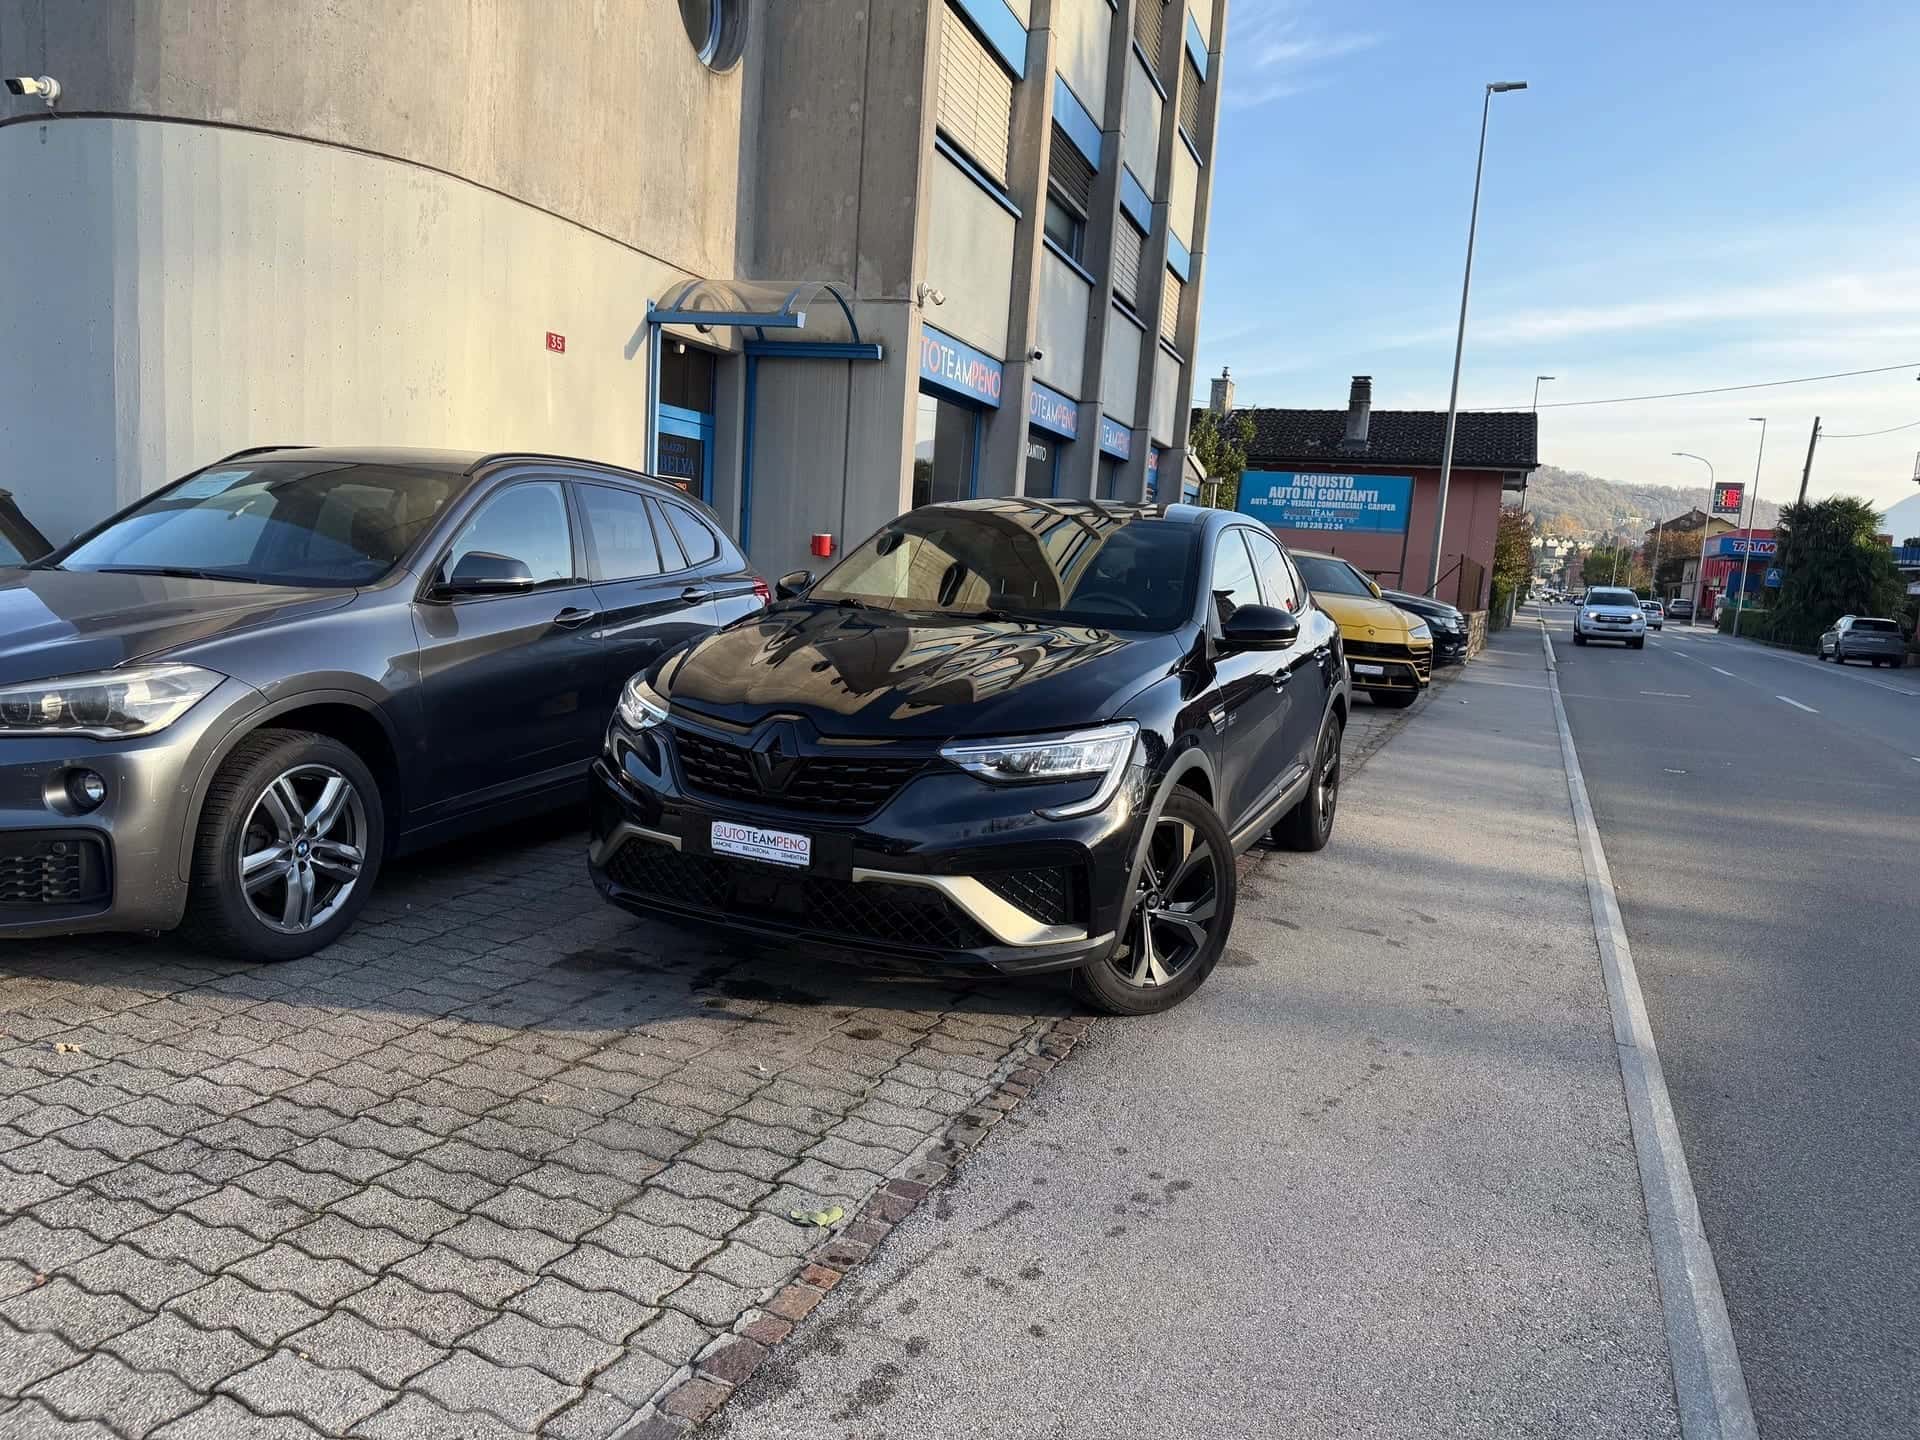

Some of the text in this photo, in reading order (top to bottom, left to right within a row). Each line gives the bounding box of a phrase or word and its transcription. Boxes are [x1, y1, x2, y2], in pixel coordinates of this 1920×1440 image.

[551, 335, 562, 349] 35
[1292, 474, 1354, 488] ACQUISTO
[1268, 486, 1378, 502] AUTO IN CONTANTI
[1316, 501, 1363, 510] COMMERCIALI
[1367, 503, 1396, 512] CAMPER
